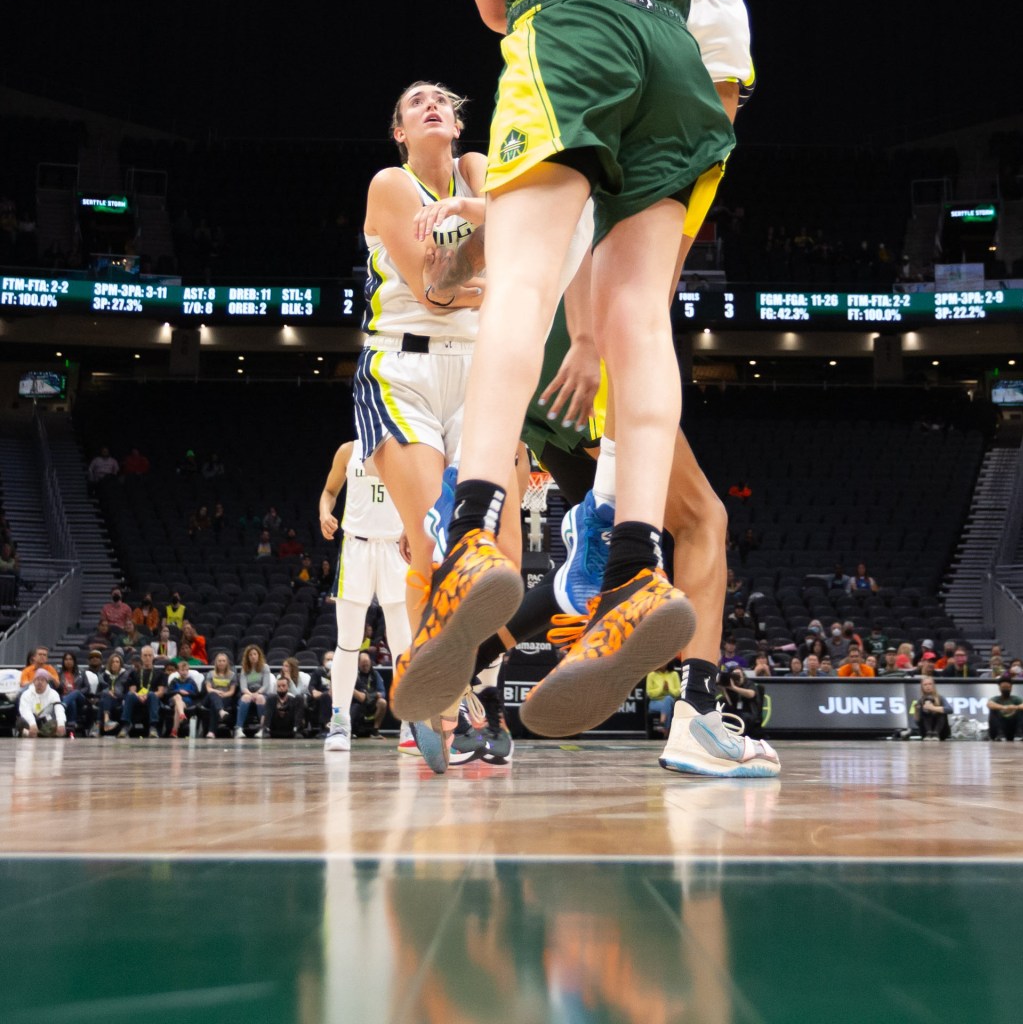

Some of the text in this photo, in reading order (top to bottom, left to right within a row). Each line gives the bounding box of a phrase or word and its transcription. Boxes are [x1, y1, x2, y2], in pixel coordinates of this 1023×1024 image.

[2, 277, 69, 294] FTM-FTA: 2-2
[93, 282, 168, 299] 3PM-3PA: 3-11
[1, 291, 58, 307] FT: 100.0%
[183, 287, 216, 300] AST: 8
[228, 288, 271, 301] DREB: 11
[281, 288, 312, 301] STL: 4
[679, 293, 700, 302] FOULS
[760, 293, 838, 307] FGM-FGA: 11-26
[847, 294, 911, 307] FTM-FTA: 2-2
[934, 291, 1004, 306] 3PM-3PA: 2-9
[93, 297, 143, 312] 3P: 27.3%
[183, 302, 213, 314] T/O: 8
[228, 303, 267, 315] OREB: 2
[281, 303, 313, 316] BLK: 3
[343, 299, 353, 314] 2
[684, 302, 695, 318] 5
[724, 303, 734, 318] 3
[760, 308, 809, 320] FG: 42.3%
[848, 308, 902, 321] FT: 100.0%
[934, 305, 986, 320] 3P: 22.2%
[371, 484, 385, 503] 15
[515, 642, 552, 652] amazon
[818, 697, 886, 715] JUNE
[889, 697, 904, 715] 5
